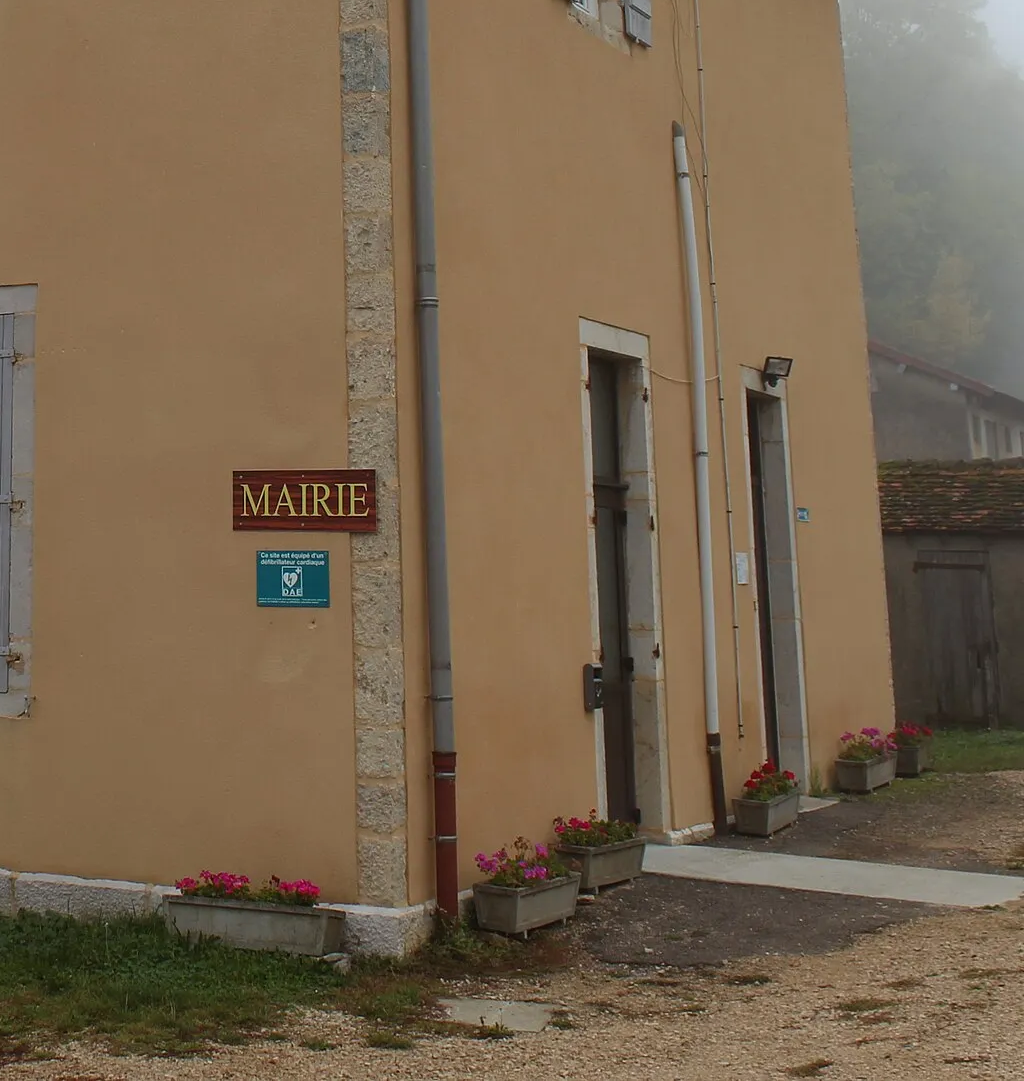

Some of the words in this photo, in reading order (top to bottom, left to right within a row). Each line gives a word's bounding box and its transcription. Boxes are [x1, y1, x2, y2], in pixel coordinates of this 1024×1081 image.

[240, 483, 370, 517] MAIRIE
[290, 552, 310, 560] équipé
[283, 588, 302, 596] DAE
